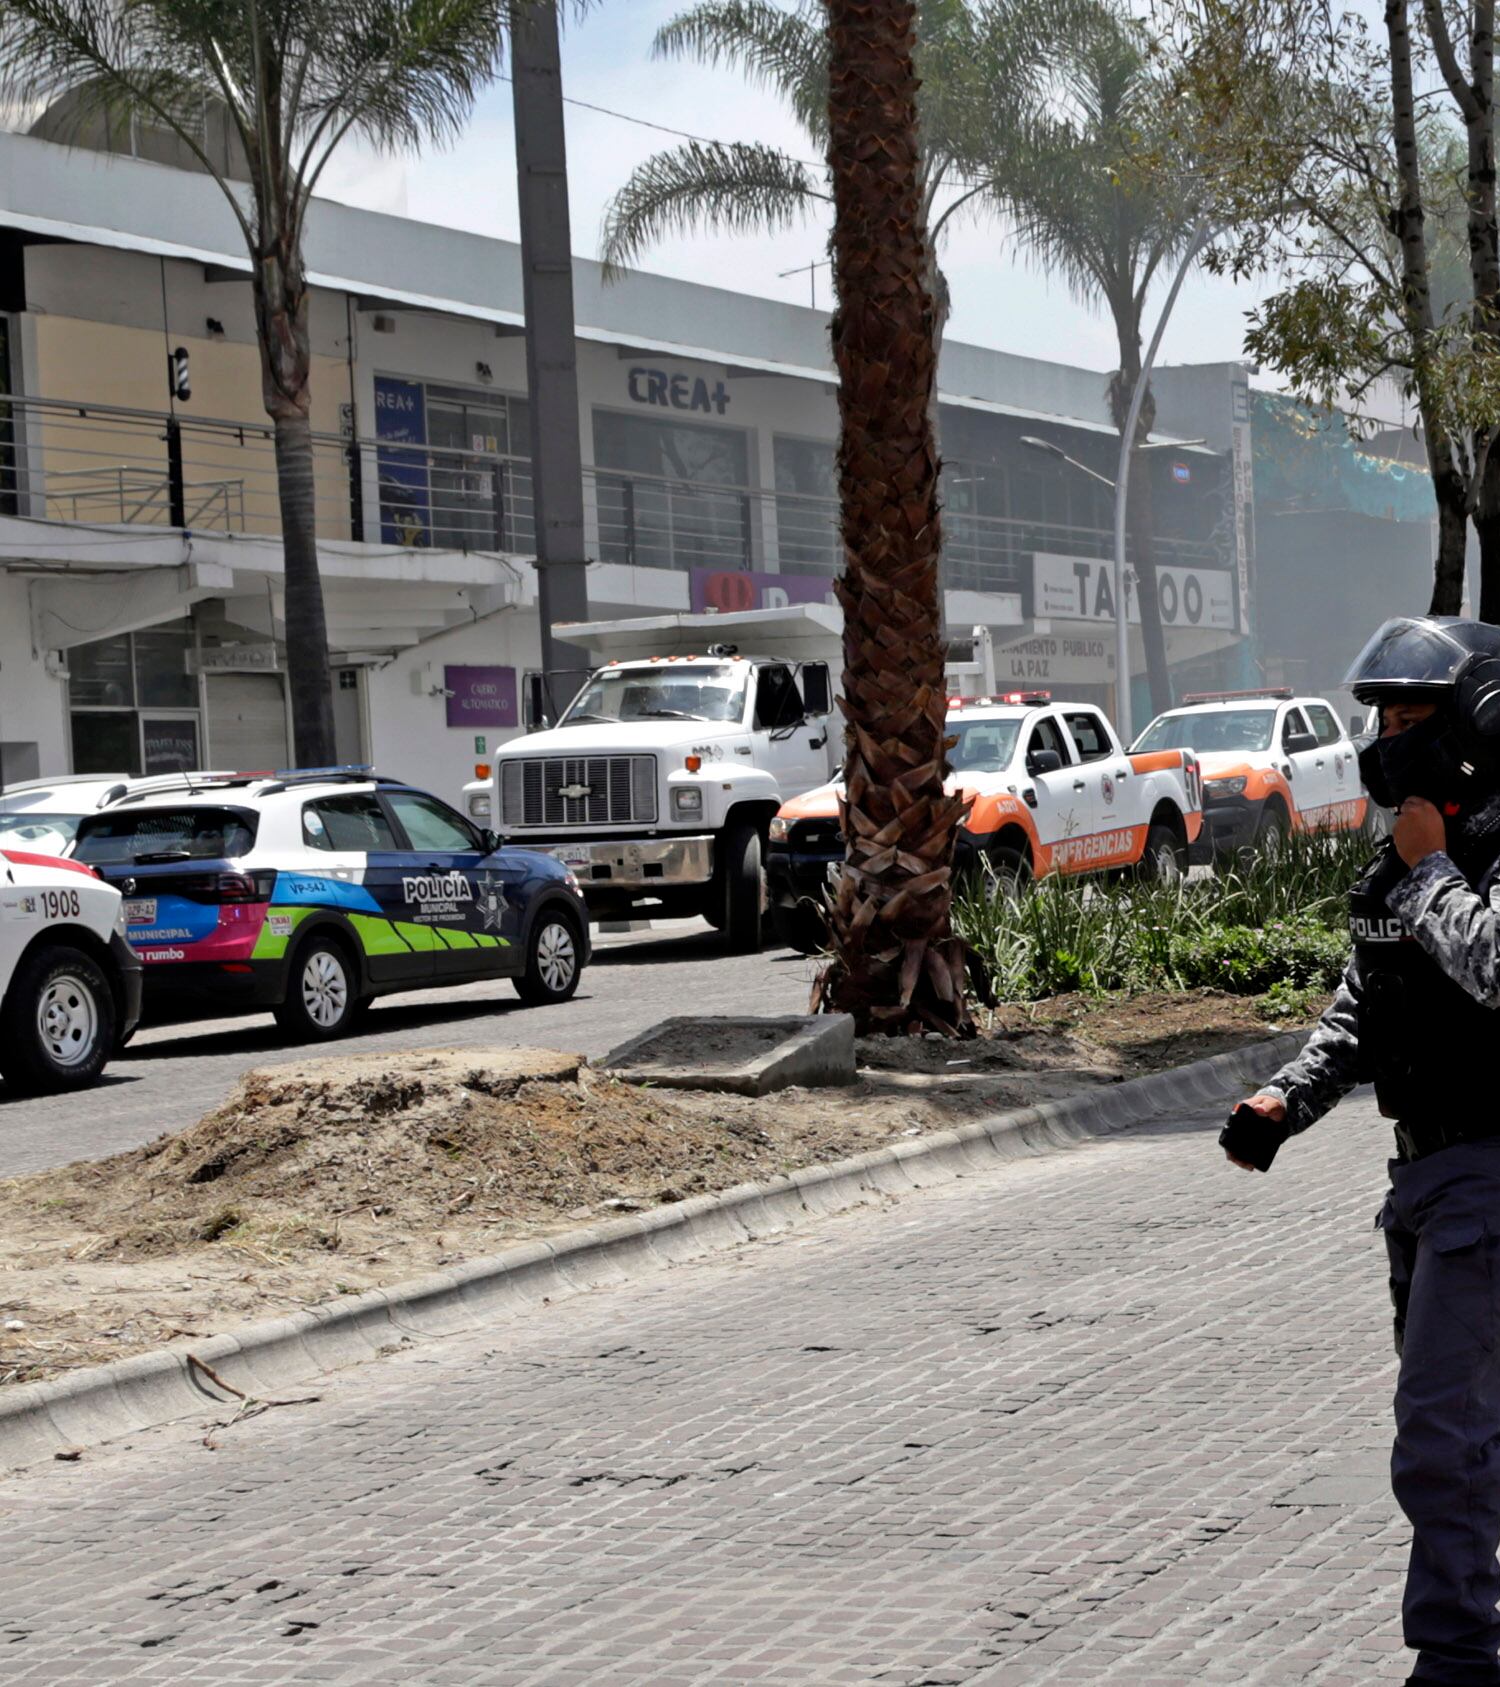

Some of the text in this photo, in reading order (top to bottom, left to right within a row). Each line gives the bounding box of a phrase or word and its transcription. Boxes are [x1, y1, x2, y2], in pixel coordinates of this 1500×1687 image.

[375, 391, 415, 411] REA+
[1063, 639, 1104, 657] PUBLICO
[1011, 659, 1050, 677] LA PAZ
[290, 882, 327, 895] VP-542
[41, 890, 80, 919] 1908
[421, 902, 458, 913] MUNICIPAL
[127, 928, 193, 941] MUNICIPAL
[1349, 917, 1411, 937] POLIC
[147, 948, 184, 961] rumbo
